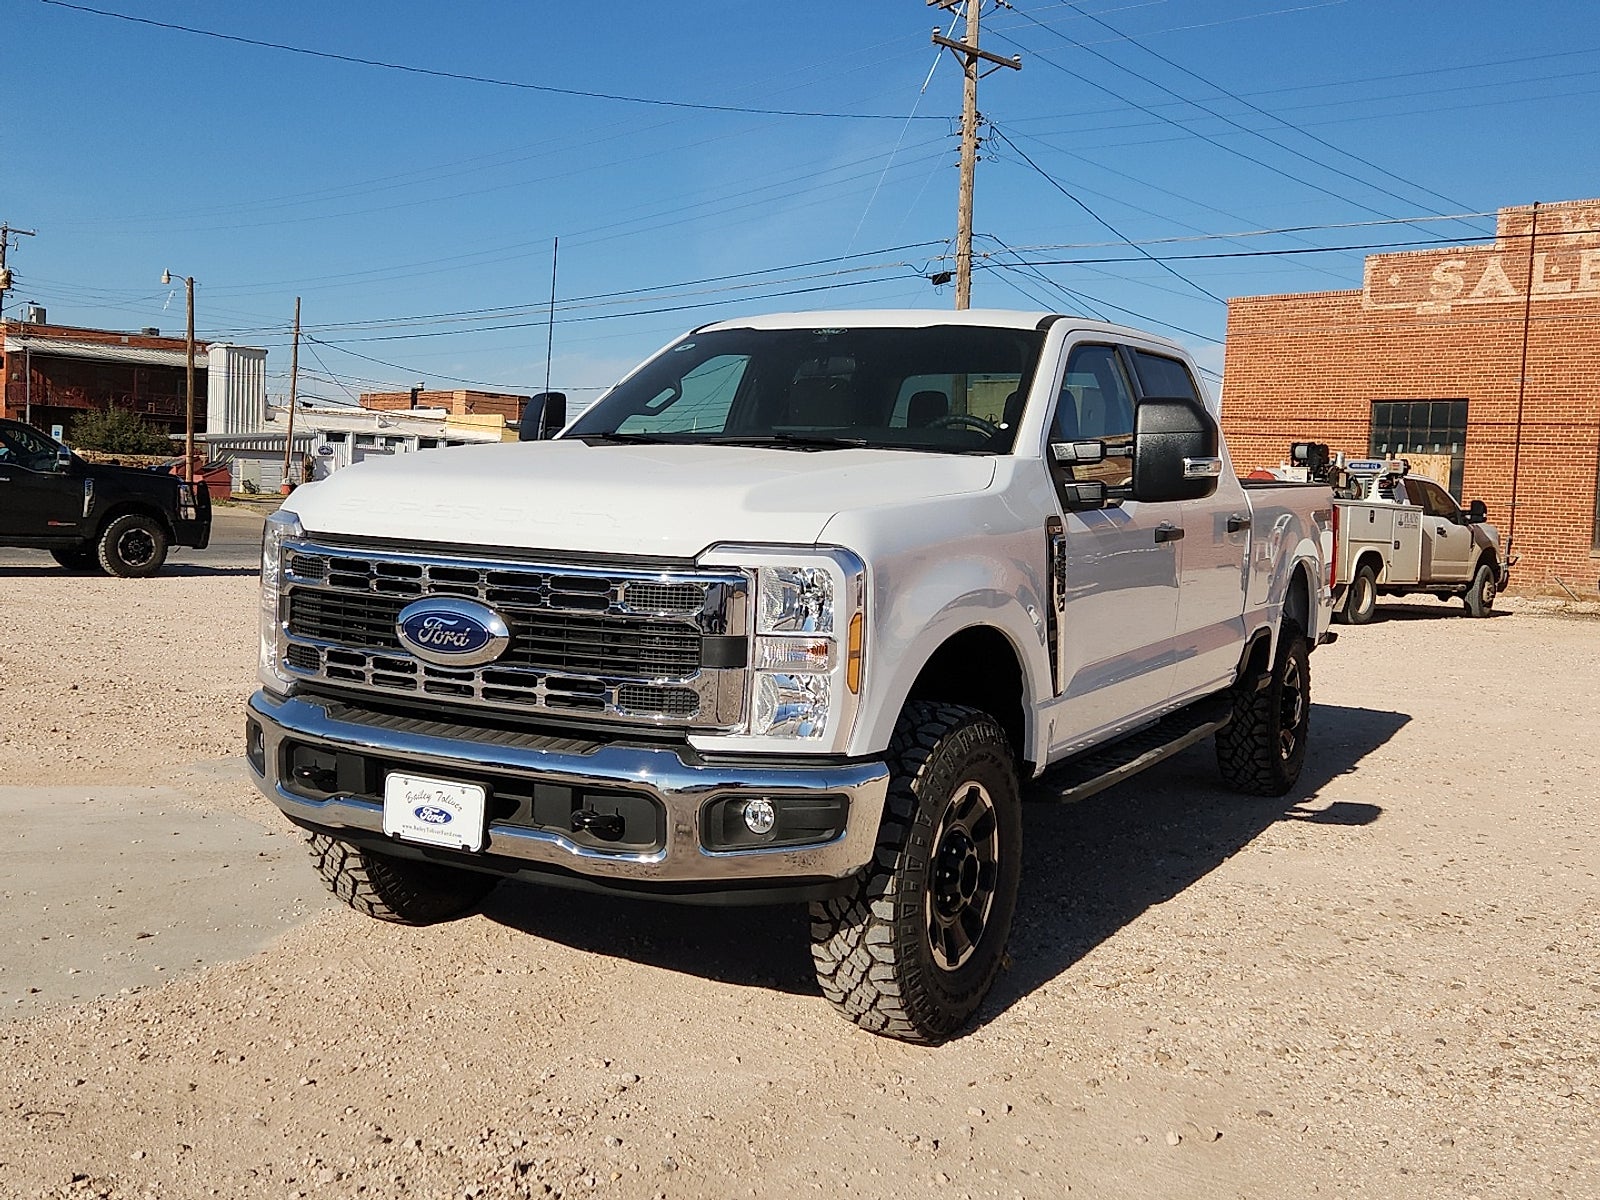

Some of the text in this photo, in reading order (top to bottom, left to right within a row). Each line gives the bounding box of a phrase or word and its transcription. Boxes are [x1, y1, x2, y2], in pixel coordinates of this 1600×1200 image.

[417, 616, 470, 648] Ford
[435, 790, 462, 811] Toliver
[419, 807, 446, 823] Ford
